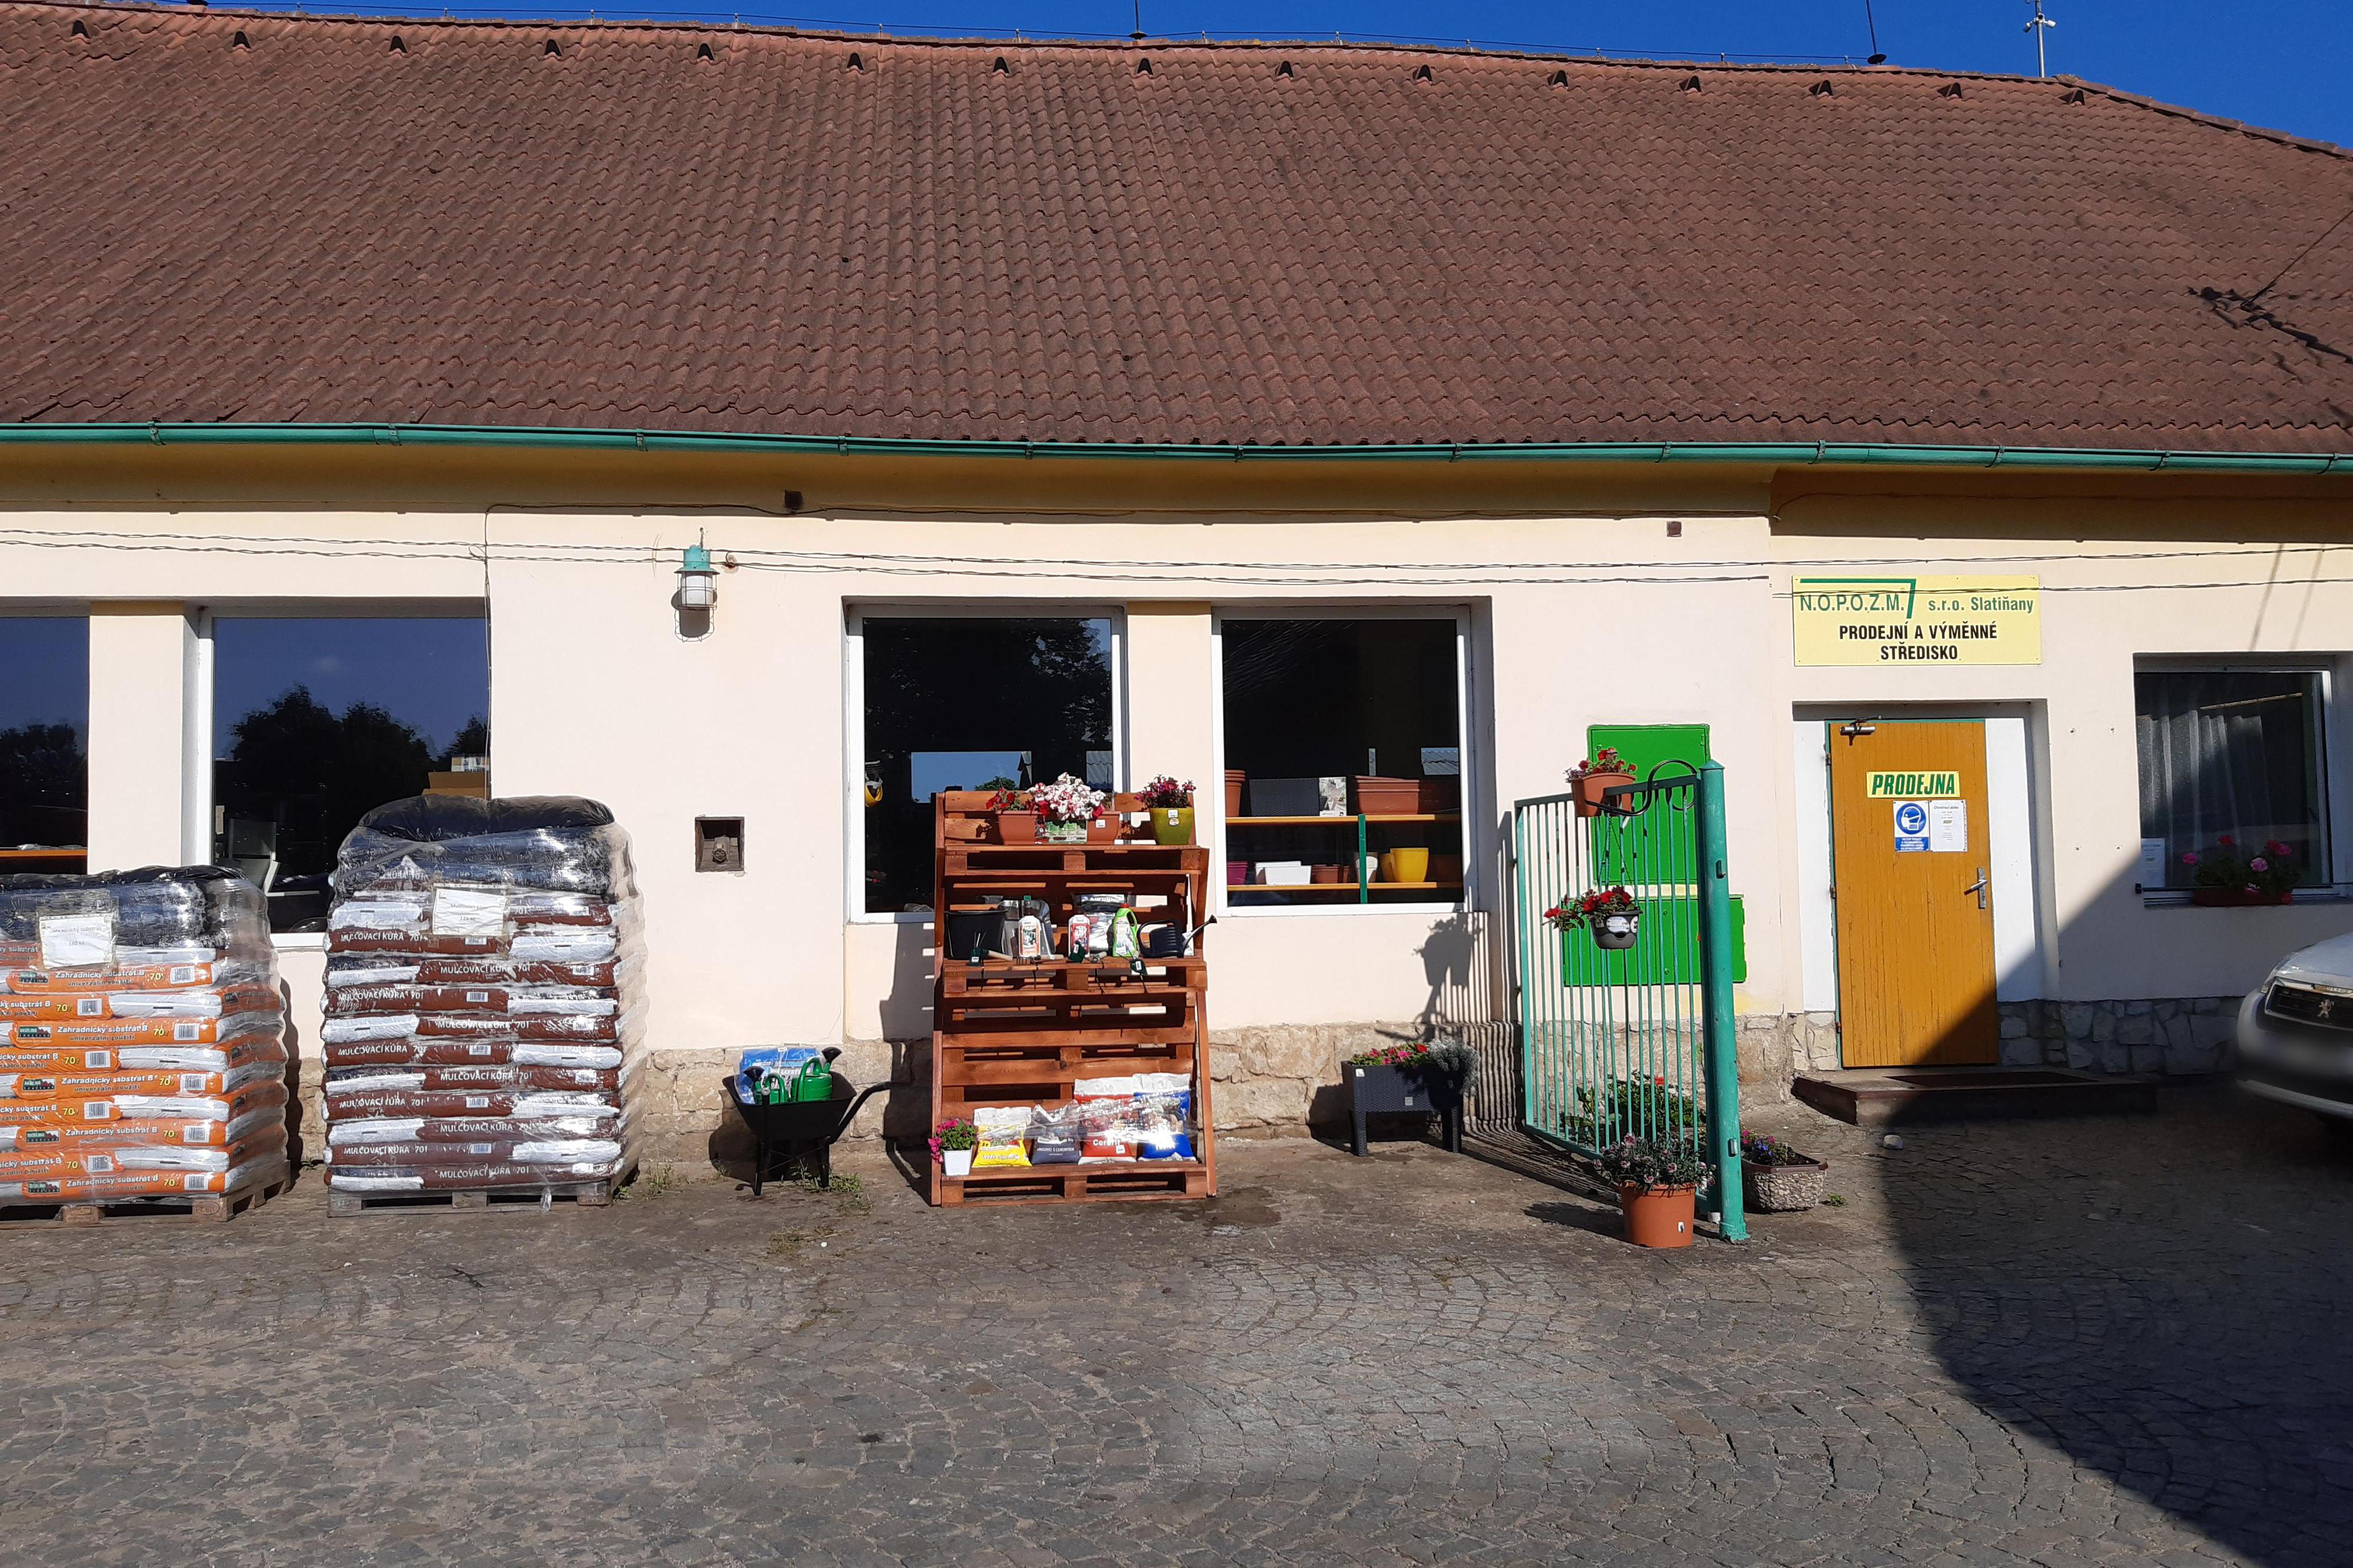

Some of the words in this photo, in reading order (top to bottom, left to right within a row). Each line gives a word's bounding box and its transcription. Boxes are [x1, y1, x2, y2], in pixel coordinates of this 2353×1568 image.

[1799, 593, 1905, 612] N.O.P.O.Z.M.
[1928, 600, 1965, 611] s.r.o.
[1971, 596, 2034, 613] Slatiňany
[1839, 621, 1908, 640] PRODEJNÍ
[1914, 626, 1924, 639] A
[1929, 621, 1997, 639] VÝMĚNNÉ
[1880, 642, 1958, 660] STŘEDISKO
[1871, 773, 1955, 795] PRODEJNA
[66, 1179, 115, 1187] Zahradnický
